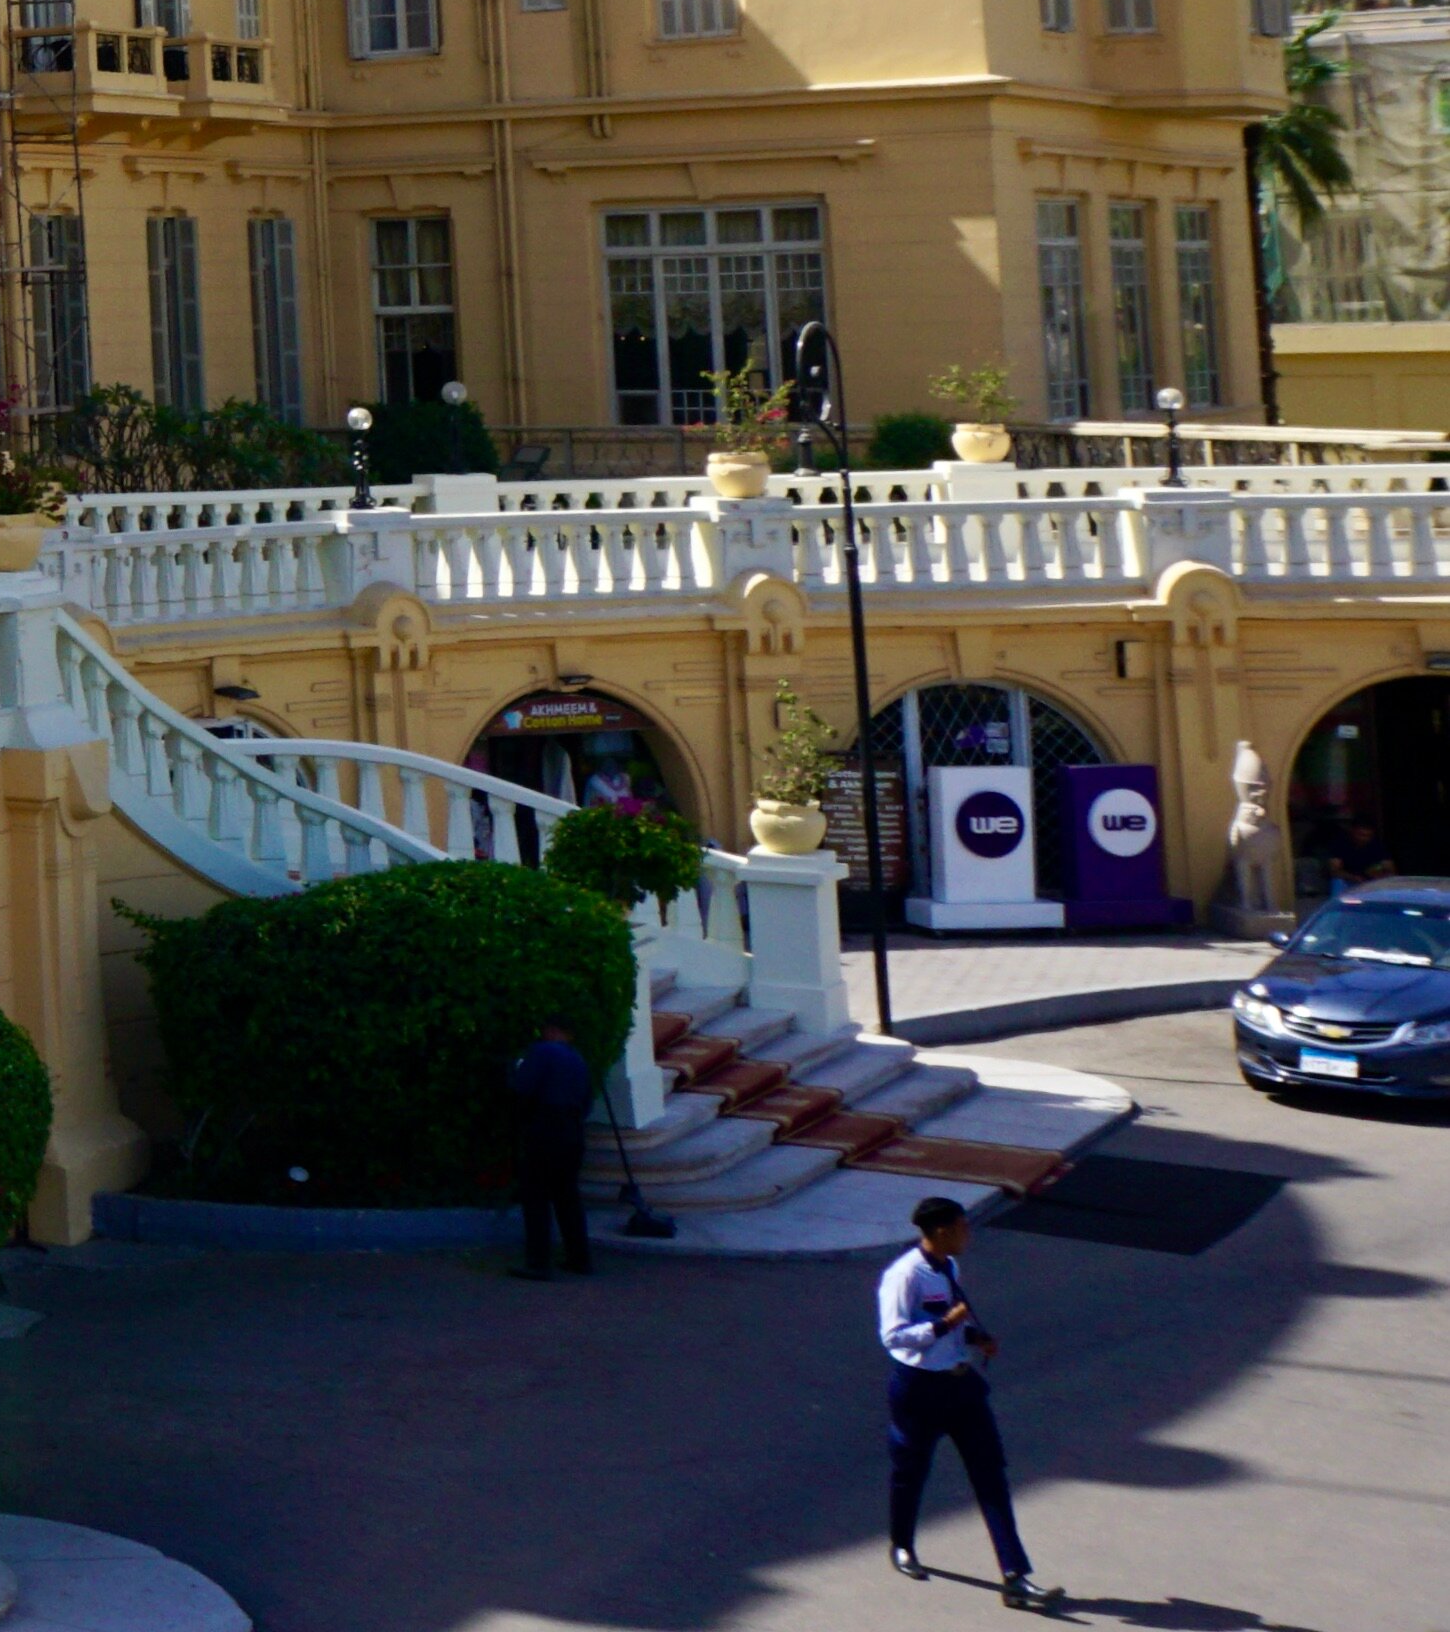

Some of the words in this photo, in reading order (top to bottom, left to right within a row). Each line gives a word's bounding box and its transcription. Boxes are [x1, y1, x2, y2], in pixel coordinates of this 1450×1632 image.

[531, 703, 586, 715] AKHMEEM
[588, 703, 597, 713] &
[969, 816, 1019, 834] we
[1102, 815, 1147, 832] we
